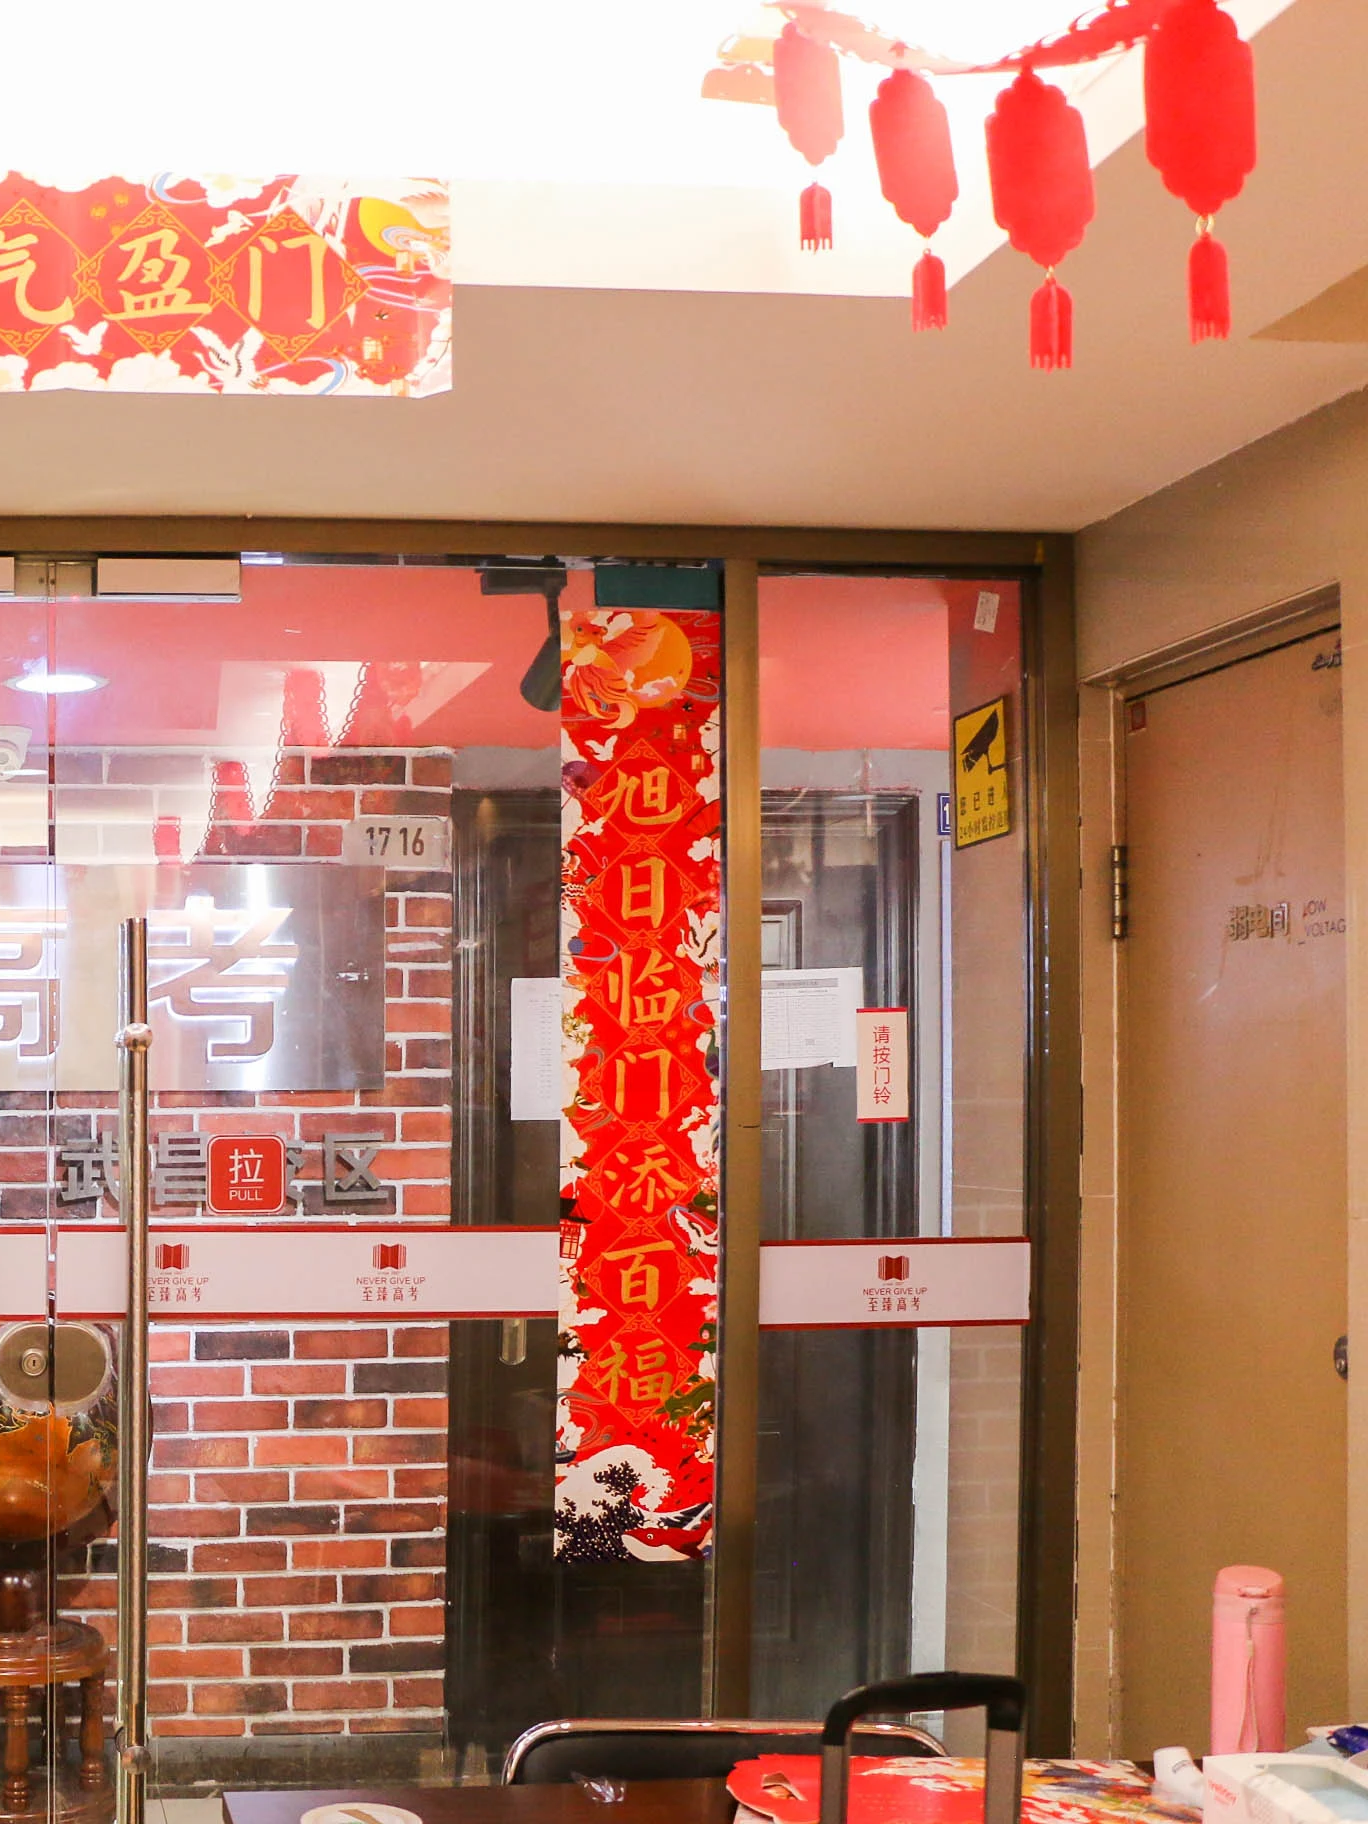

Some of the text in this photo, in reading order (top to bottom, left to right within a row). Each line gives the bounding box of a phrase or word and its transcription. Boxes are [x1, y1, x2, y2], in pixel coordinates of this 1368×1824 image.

[365, 826, 425, 856] 1716
[872, 1026, 892, 1105] 请按门铃
[597, 764, 689, 1404] 旭日临门添百福
[229, 1148, 264, 1184] 拉
[229, 1190, 263, 1201] PULL
[147, 1277, 209, 1285] EVER GIVE UP
[356, 1276, 426, 1285] NEVER GIVE UP
[862, 1287, 928, 1296] NEVER GIVE UP
